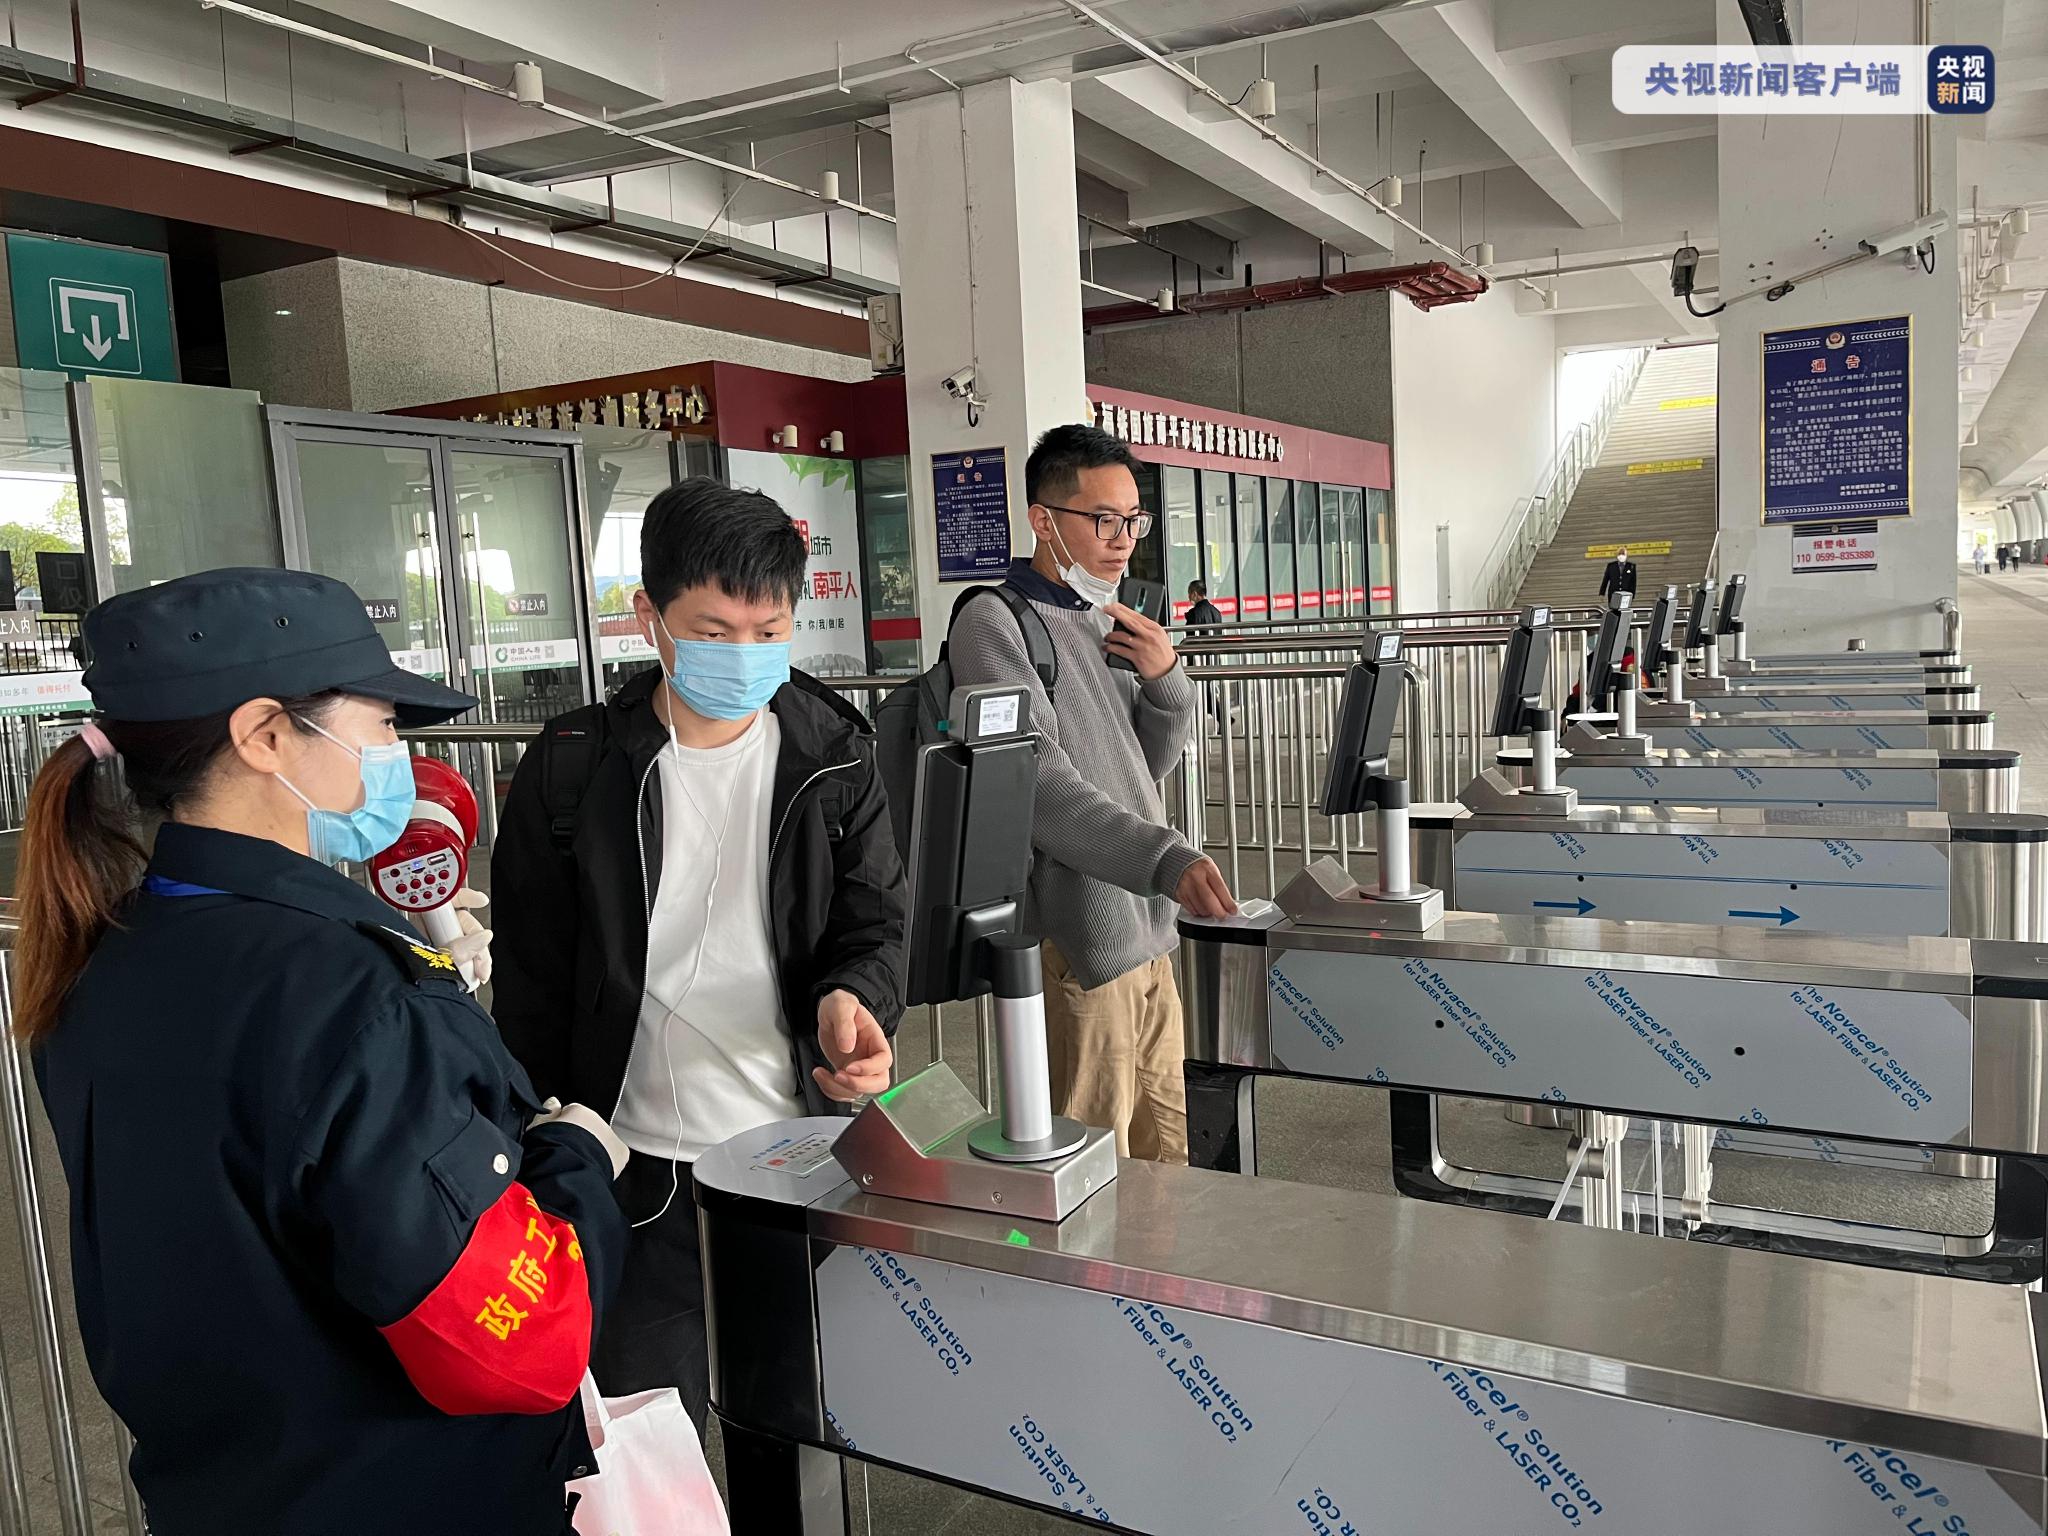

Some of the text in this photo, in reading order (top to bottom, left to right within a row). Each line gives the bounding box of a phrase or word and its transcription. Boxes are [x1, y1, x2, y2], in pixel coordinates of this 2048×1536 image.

[1796, 553, 1811, 563] 110
[1813, 538, 1857, 549] 报警电话
[365, 604, 397, 619] 禁止入内
[520, 599, 546, 611] 禁止入内
[1567, 846, 1580, 860] The
[1698, 850, 1712, 865] The
[1841, 854, 1855, 869] The
[1274, 985, 1295, 1006] Fiber
[1292, 1005, 1300, 1013] &
[1298, 1010, 1323, 1036] LASER
[1310, 1007, 1344, 1045] Solution
[1402, 963, 1417, 977] for
[1414, 975, 1441, 1002] LASER
[1440, 1000, 1461, 1022] Fiber
[1460, 1020, 1467, 1028] &
[1465, 1025, 1493, 1054] LASER
[1411, 958, 1430, 975] The
[1479, 1022, 1517, 1062] Solution
[1584, 976, 1600, 990] for
[1598, 989, 1627, 1018] LASER
[1625, 1016, 1650, 1039] Fiber
[1647, 1037, 1655, 1046] &
[1654, 1043, 1684, 1072] LASER
[1594, 970, 1614, 988] The
[1669, 1039, 1712, 1081] Solution
[1790, 990, 1807, 1006] for
[1805, 1004, 1838, 1035] LASER
[1836, 1033, 1863, 1058] Fiber
[1861, 1057, 1869, 1065] &
[1868, 1062, 1902, 1094] LASER
[1802, 985, 1824, 1004] The
[1886, 1059, 1933, 1103] Solution
[475, 1197, 558, 1340] 政府工
[864, 1254, 895, 1290] Fiber
[892, 1292, 901, 1302] &
[900, 1300, 939, 1348] LASER
[919, 1297, 973, 1366] Solution
[1123, 1306, 1159, 1346] Fiber
[1157, 1348, 1167, 1360] &
[1166, 1358, 1212, 1412] LASER
[1189, 1355, 1253, 1432] Solution
[1009, 1424, 1065, 1496] Solution
[1442, 1371, 1487, 1418] Fiber
[1483, 1419, 1496, 1433] &
[1495, 1431, 1552, 1493] LASER
[1044, 1443, 1086, 1495] LASER
[1087, 1493, 1095, 1504] &
[1524, 1428, 1603, 1515] Solution
[1843, 1451, 1908, 1519] Fiber &
